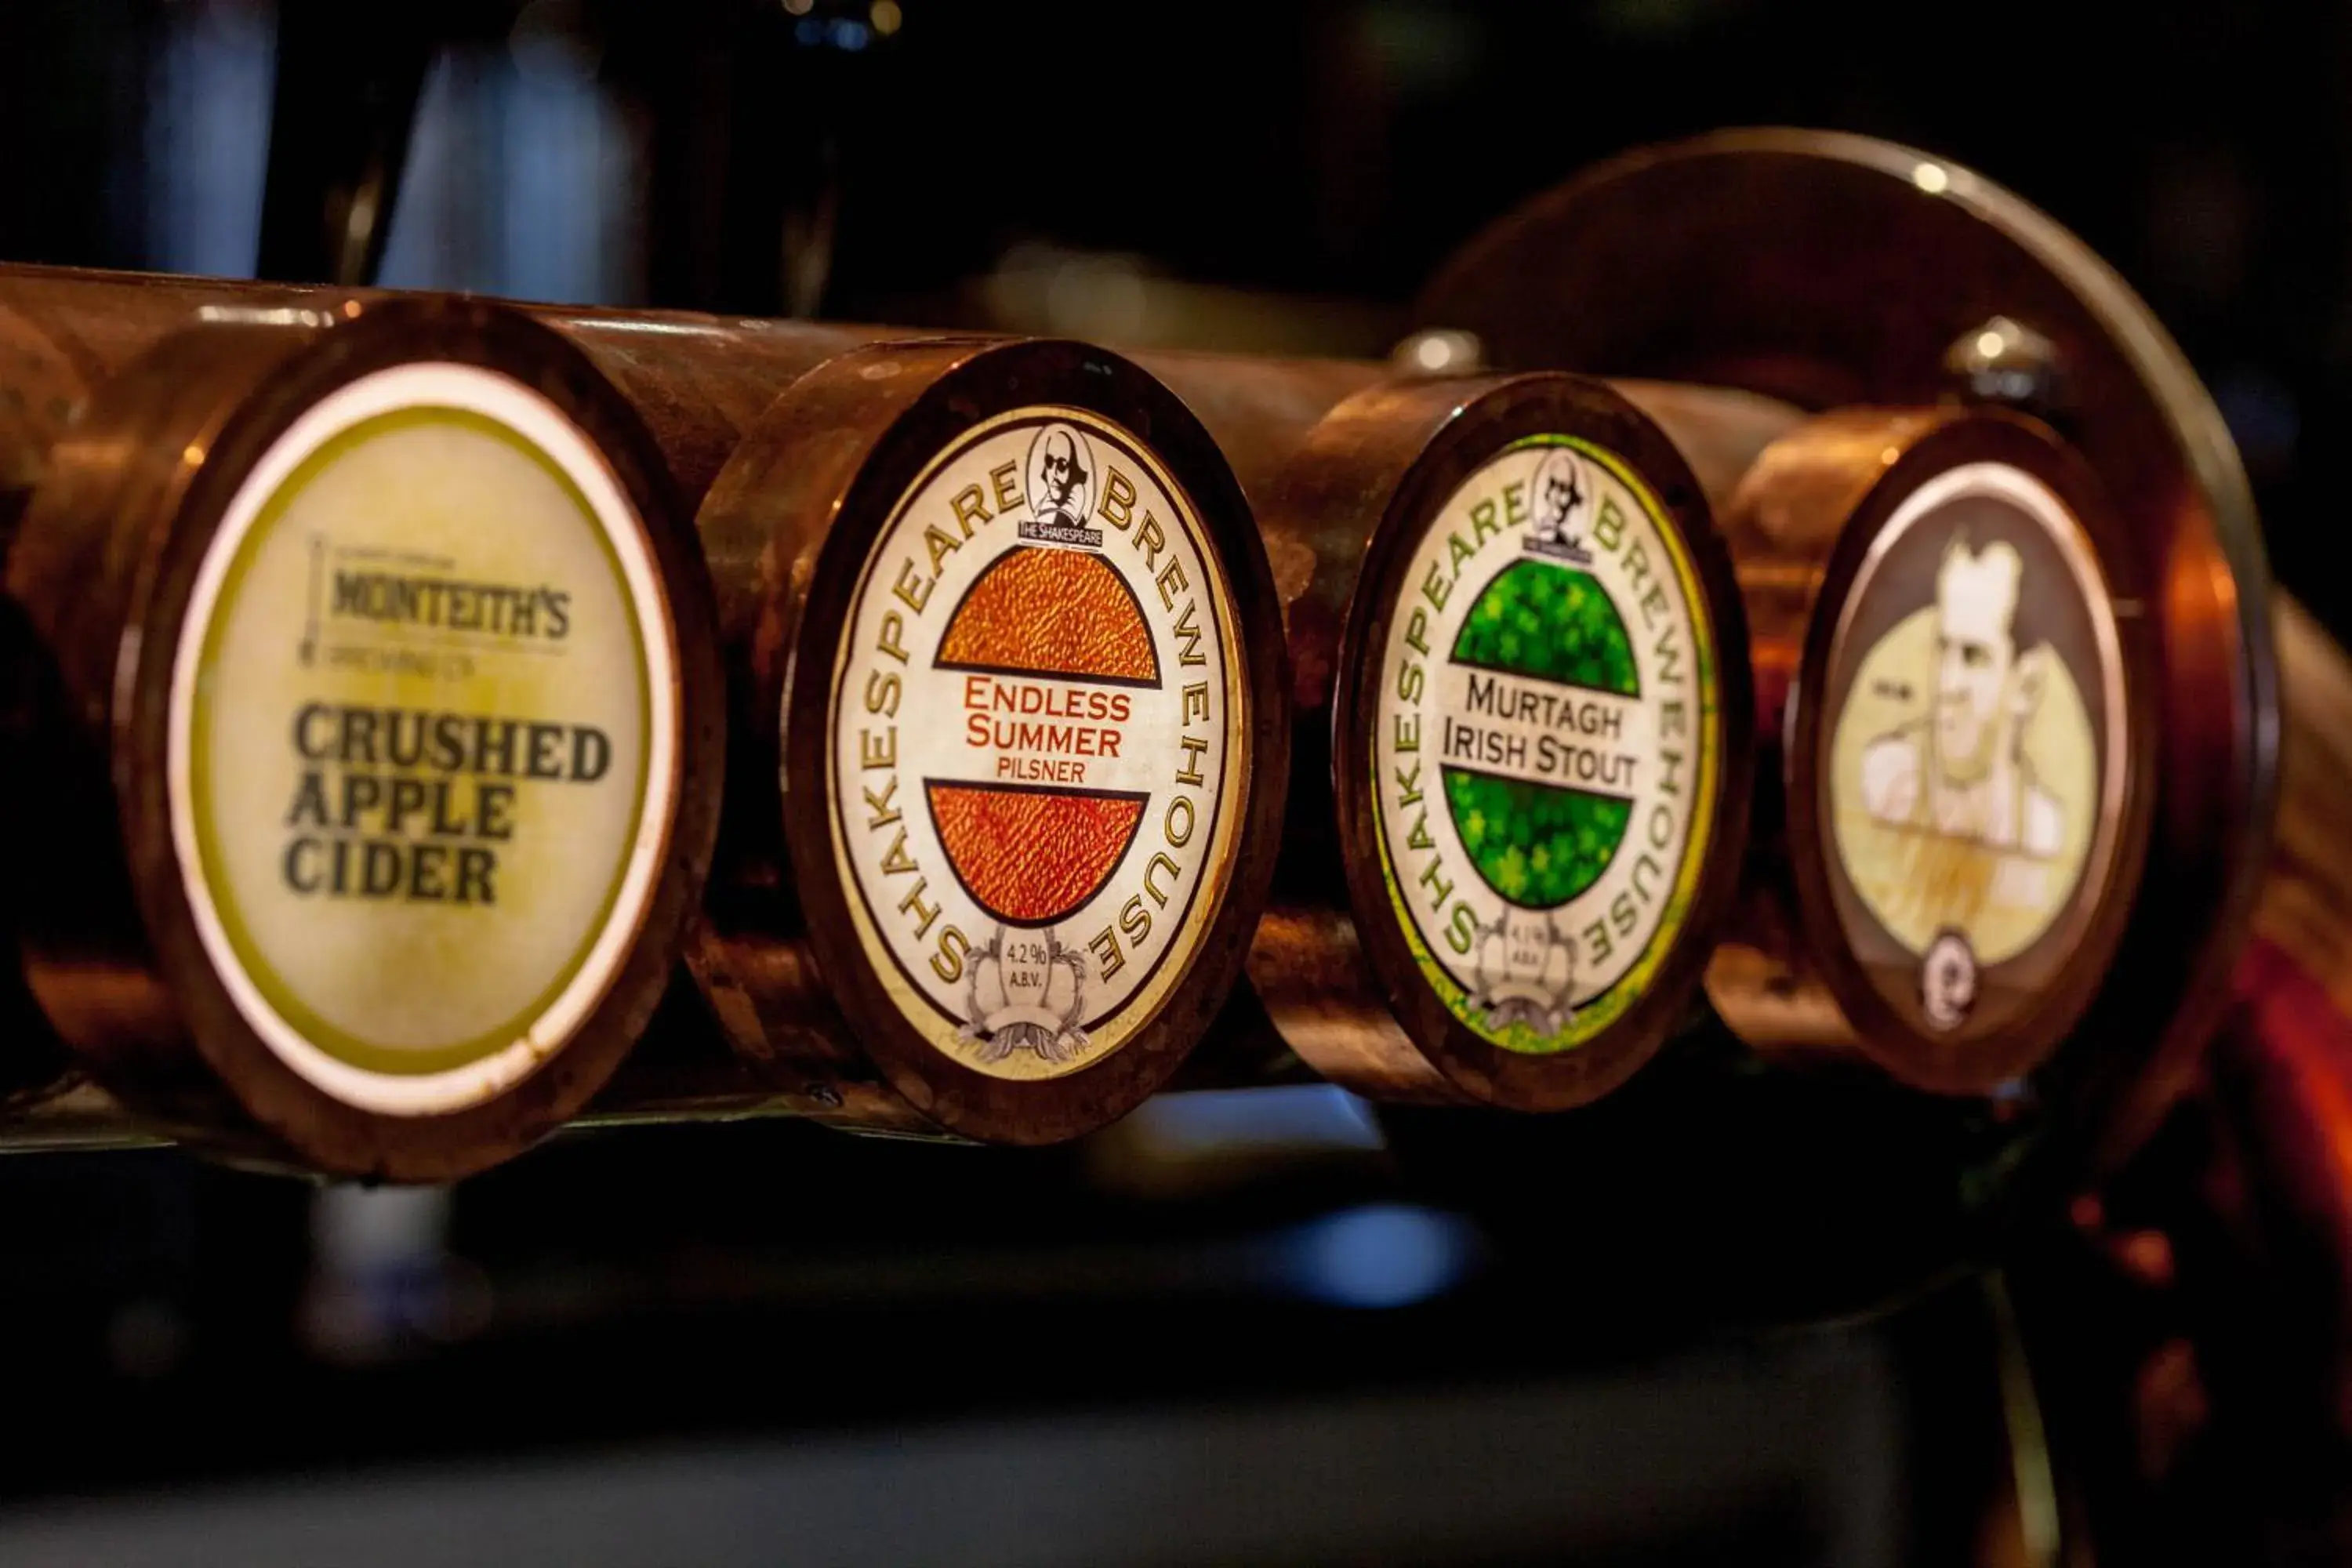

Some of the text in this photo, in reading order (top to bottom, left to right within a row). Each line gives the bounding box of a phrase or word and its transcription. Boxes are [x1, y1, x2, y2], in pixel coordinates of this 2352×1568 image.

[1020, 521, 1102, 545] THE SHAKESPEARE
[333, 568, 571, 640] MONTEITH'S
[858, 459, 1210, 984] SHAKESPEARE BREWHOUSE
[964, 676, 1131, 722] ENDLESS
[1393, 478, 1686, 970] SHAKESPEARE BREWHOUSE
[1465, 673, 1623, 739] MURTAGH
[293, 700, 612, 783] CRUSHED
[965, 713, 1122, 758] SUMMER
[996, 757, 1087, 783] PILSNER
[1443, 715, 1639, 791] IRISH STOUT
[287, 771, 514, 842] APPLE
[284, 837, 498, 906] CIDER
[1009, 971, 1043, 989] A.B.V.
